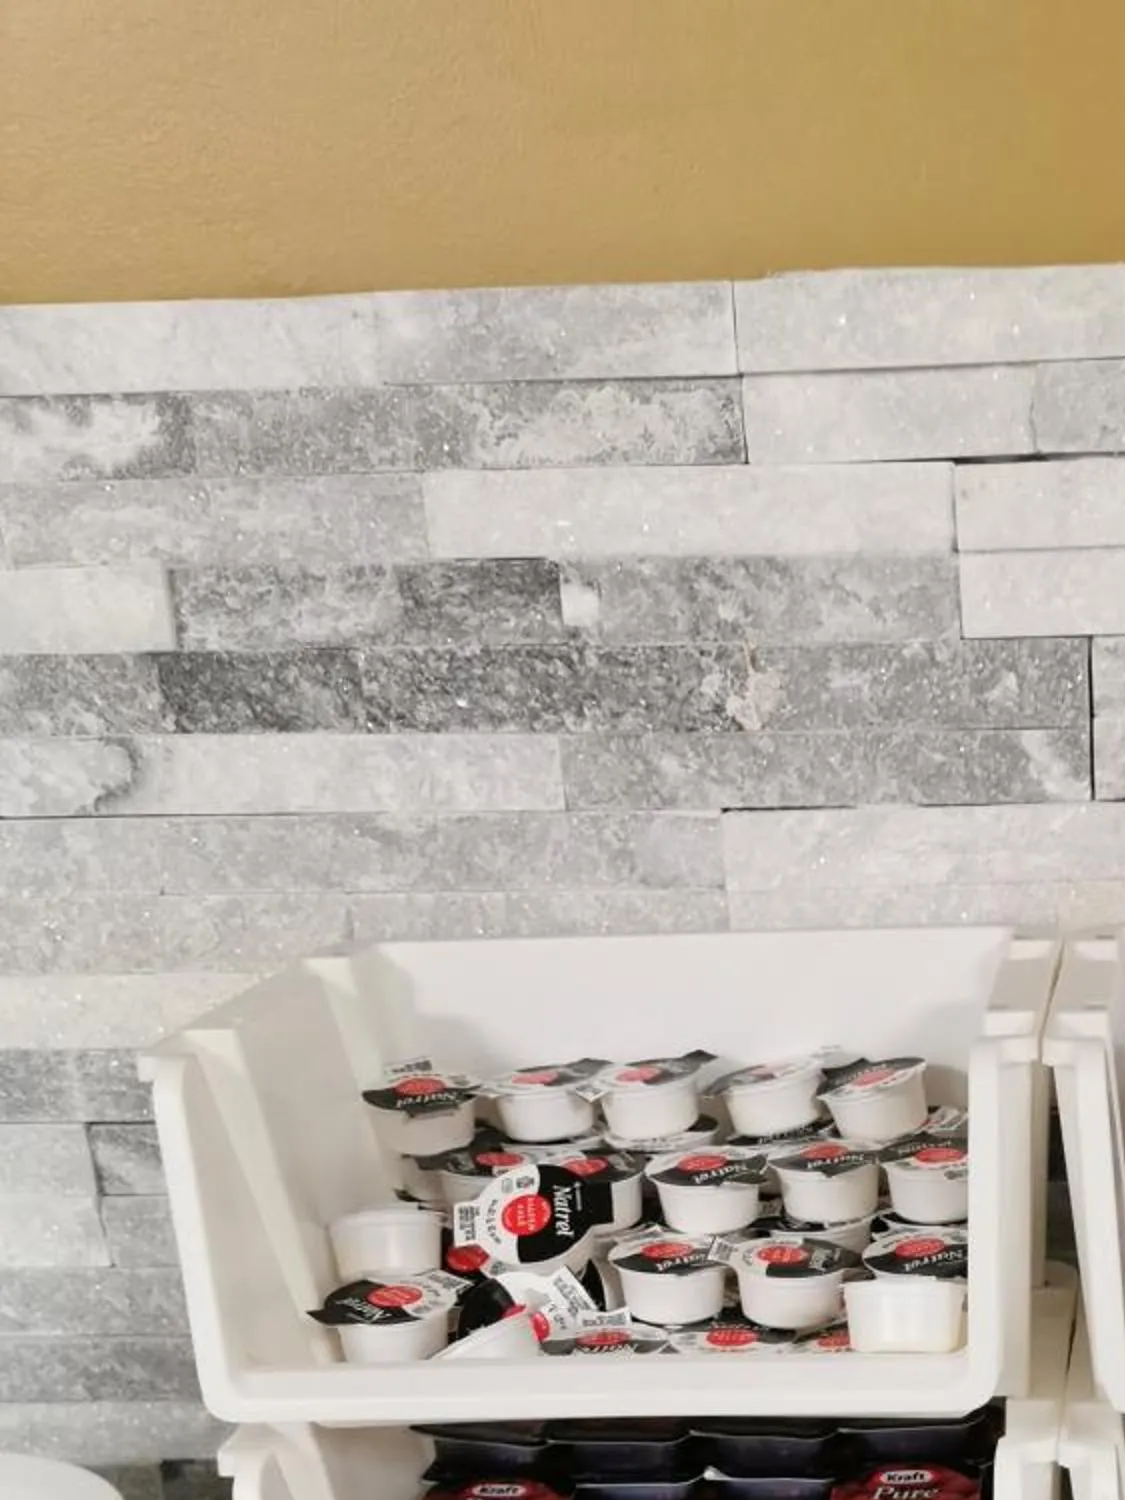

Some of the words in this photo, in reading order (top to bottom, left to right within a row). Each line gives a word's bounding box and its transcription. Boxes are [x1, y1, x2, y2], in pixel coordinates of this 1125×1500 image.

[694, 1163, 749, 1184] Natrel
[552, 1184, 575, 1237] Natrel
[886, 1472, 926, 1482] Kraft
[479, 1485, 519, 1496] Kraft
[872, 1486, 941, 1500] Pure
